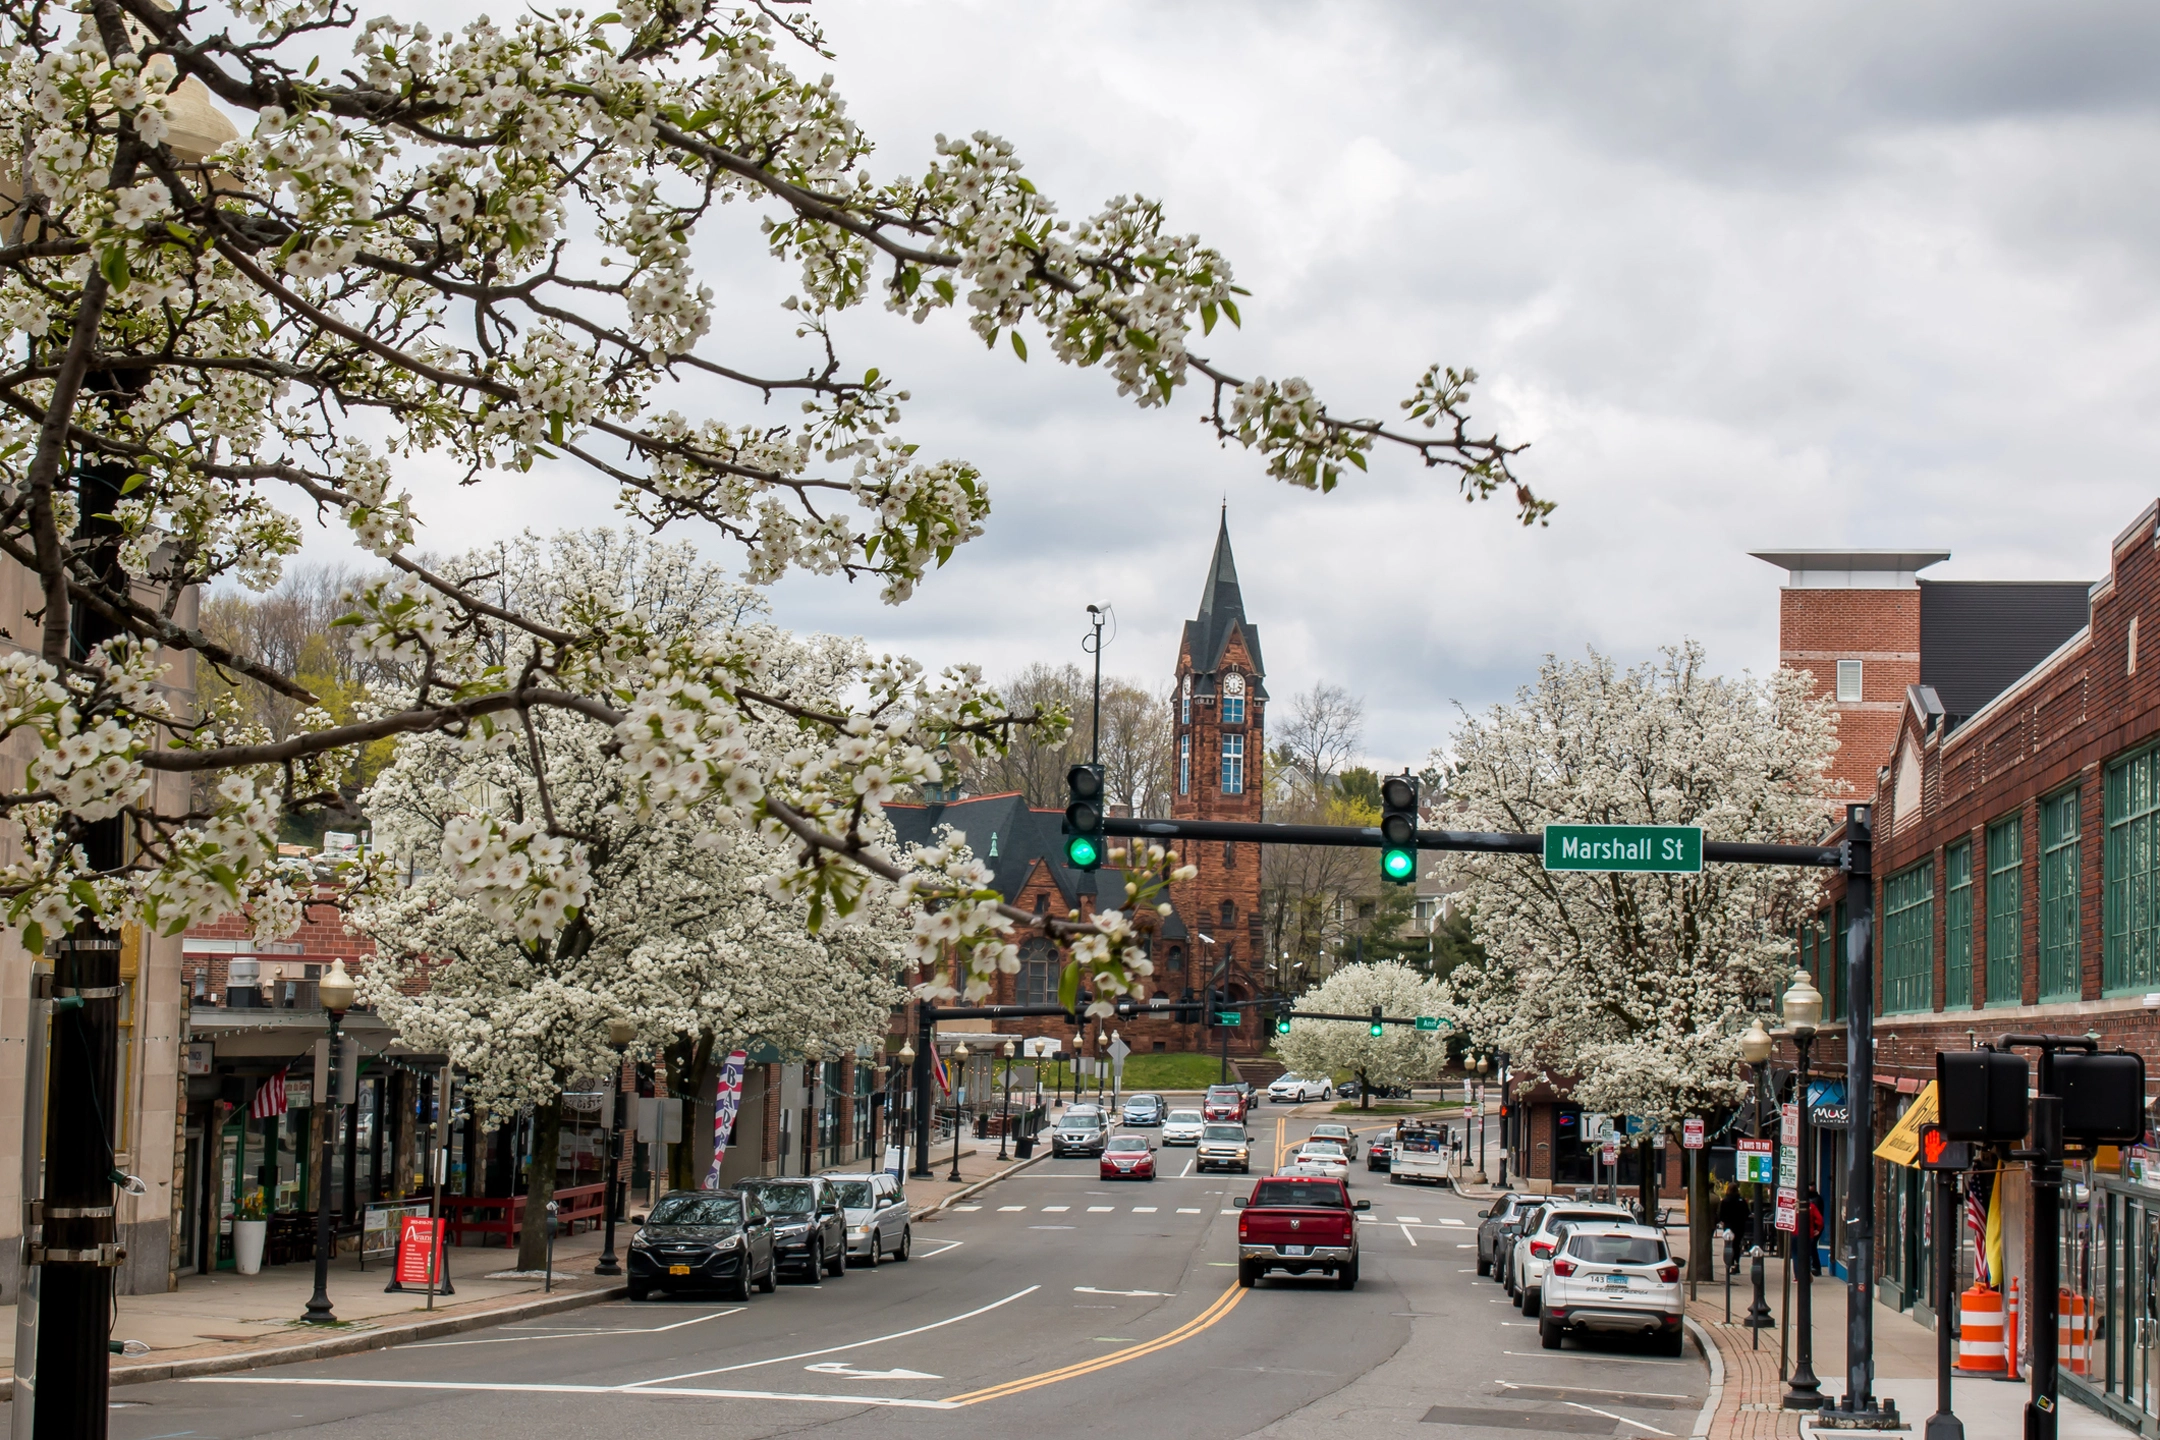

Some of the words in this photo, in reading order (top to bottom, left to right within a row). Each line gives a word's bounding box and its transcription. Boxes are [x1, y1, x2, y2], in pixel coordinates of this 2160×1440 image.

[1562, 836, 1651, 860] Marshall
[1661, 838, 1684, 861] St
[1787, 1126, 1793, 1134] TO
[1738, 1139, 1743, 1150] 3
[1755, 1141, 1761, 1150] TO
[1761, 1142, 1770, 1151] PAY
